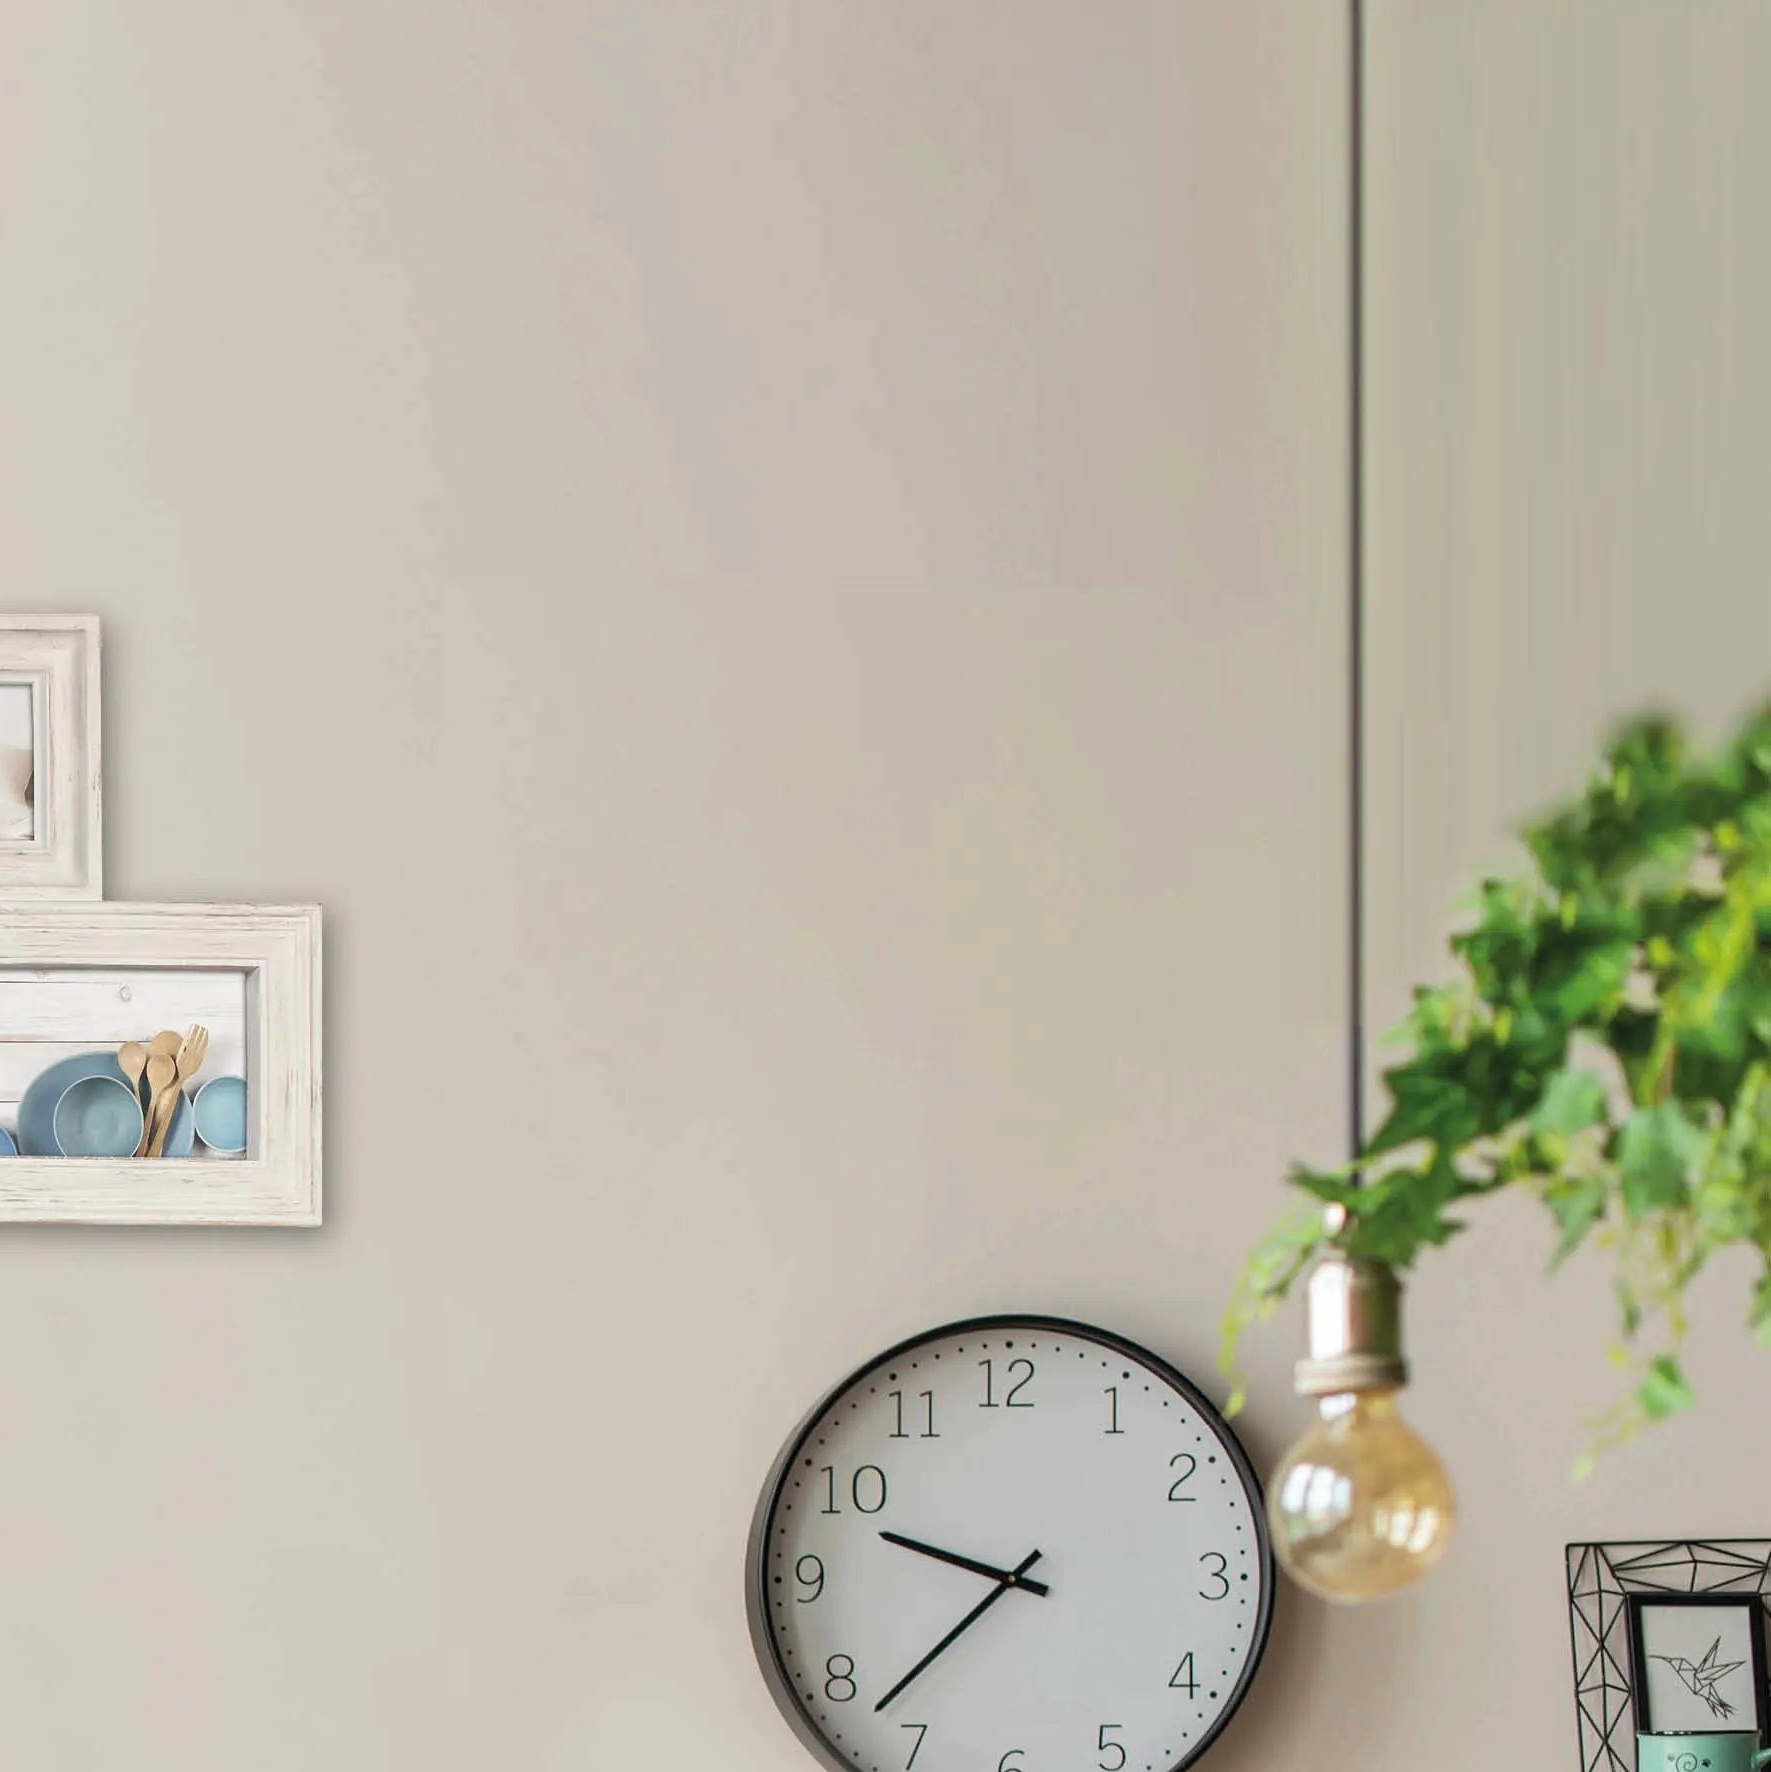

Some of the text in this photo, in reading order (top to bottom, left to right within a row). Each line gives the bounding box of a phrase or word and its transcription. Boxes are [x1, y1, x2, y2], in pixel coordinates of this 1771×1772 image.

[978, 1358, 1035, 1408] 12
[888, 1389, 941, 1438] 11
[1103, 1386, 1125, 1434] 1
[819, 1464, 887, 1515] 10
[1167, 1452, 1197, 1502] 2
[794, 1554, 825, 1603] 9
[1198, 1551, 1230, 1601] 3
[823, 1653, 857, 1703] 8
[1167, 1651, 1201, 1700] 4
[900, 1724, 928, 1772] 7
[1097, 1724, 1127, 1772] 5
